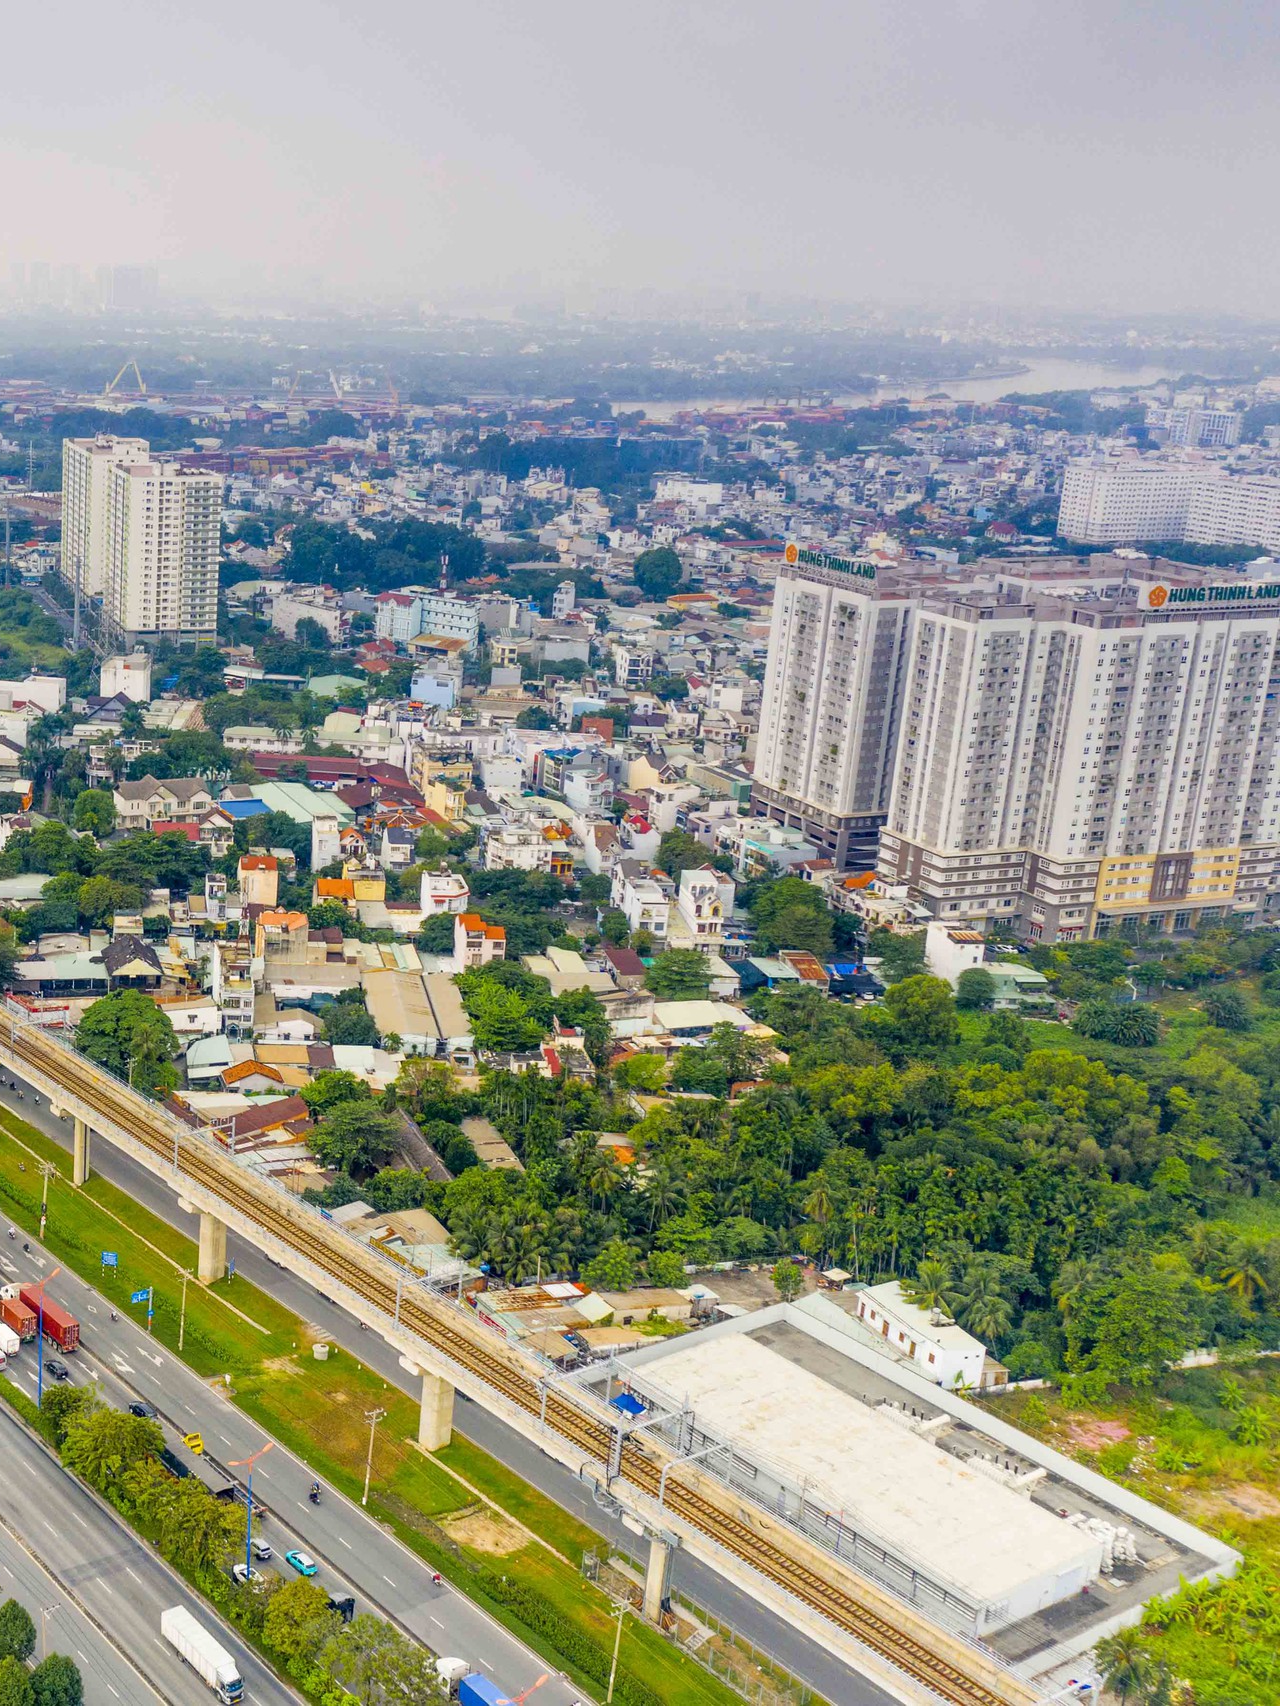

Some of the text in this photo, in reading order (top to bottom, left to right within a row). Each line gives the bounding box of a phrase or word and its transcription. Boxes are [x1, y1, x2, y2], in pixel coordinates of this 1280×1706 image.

[798, 549, 876, 580] HUNG THINH LAND
[1168, 584, 1280, 603] HUNG THINH LAND
